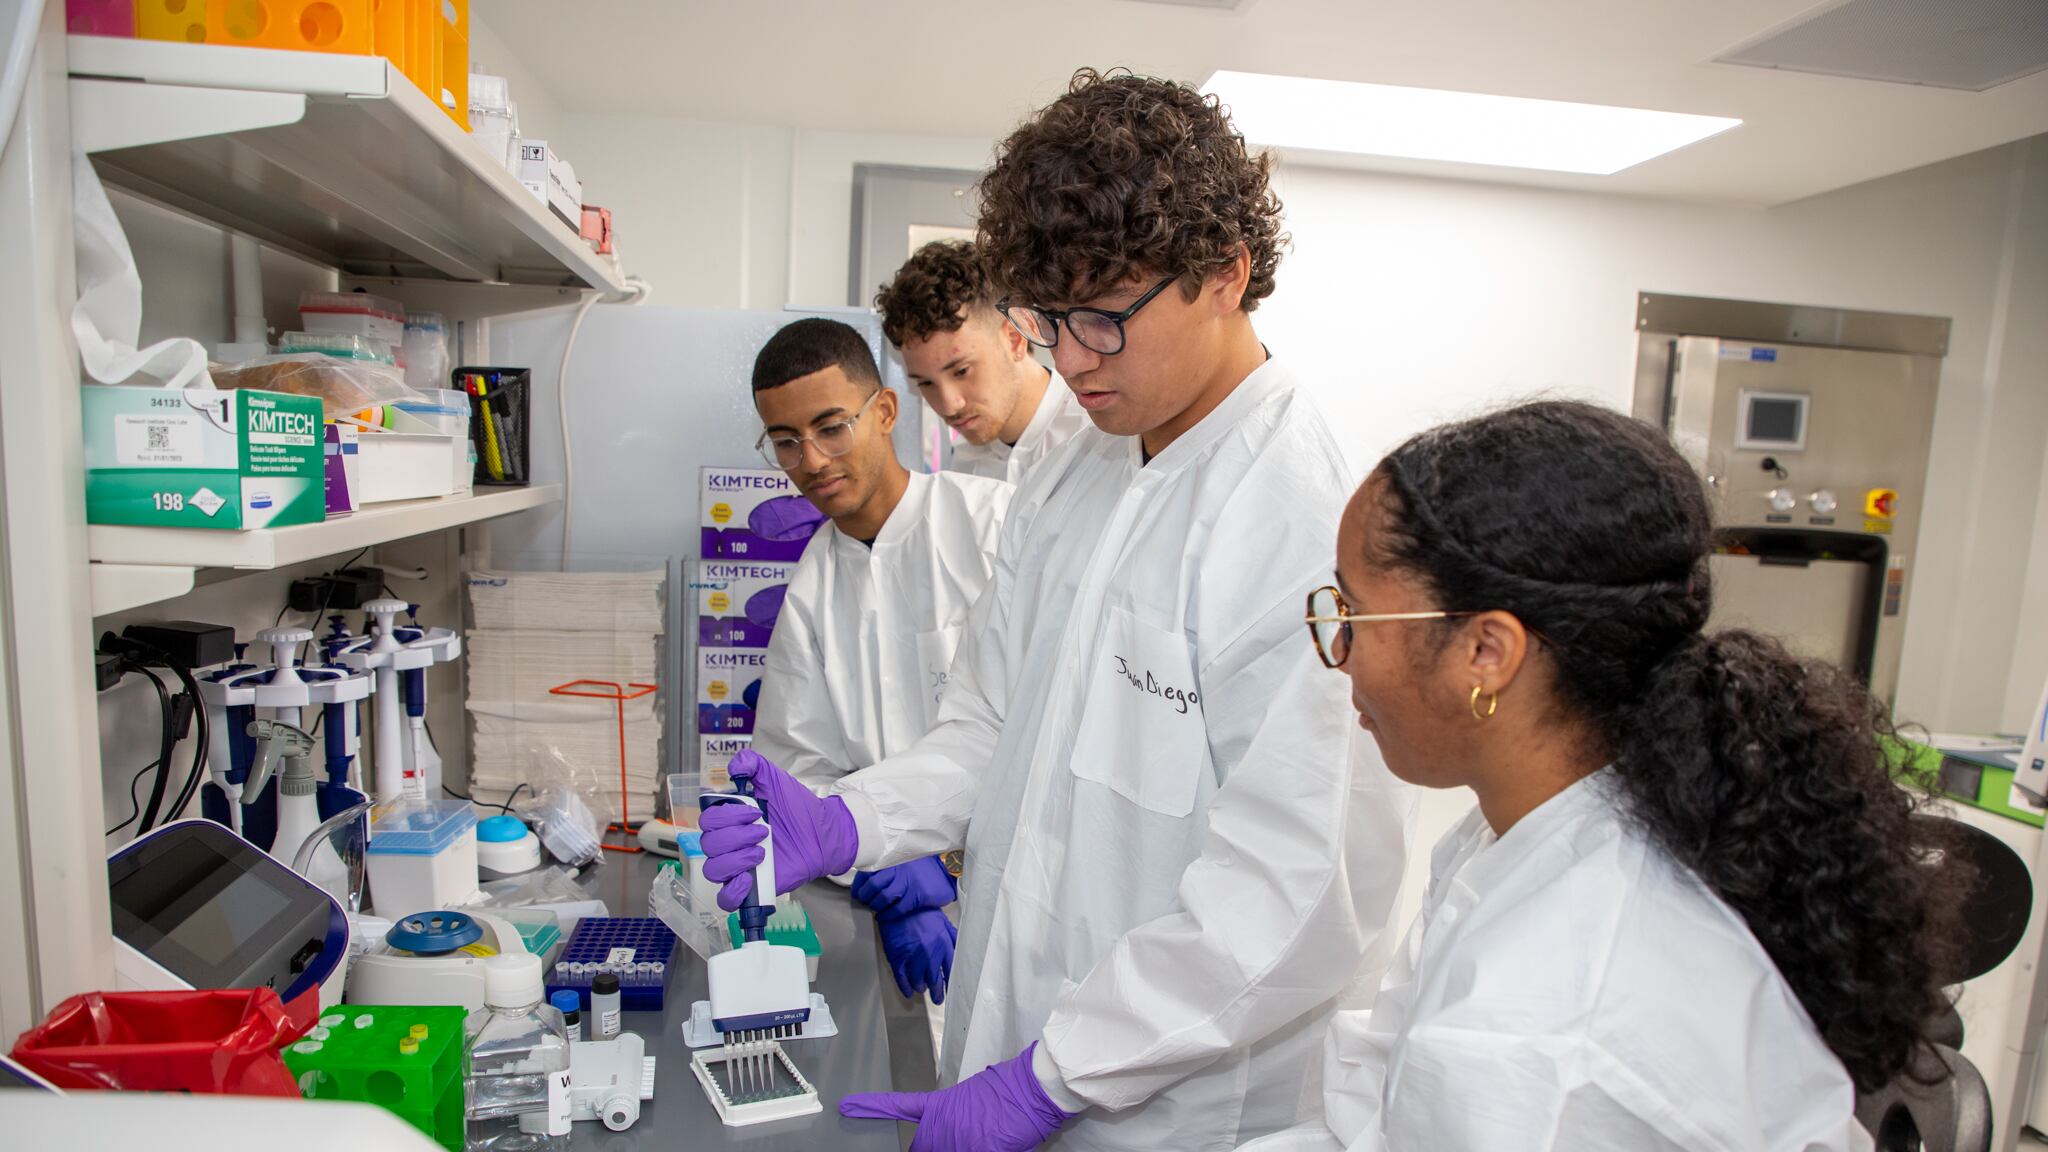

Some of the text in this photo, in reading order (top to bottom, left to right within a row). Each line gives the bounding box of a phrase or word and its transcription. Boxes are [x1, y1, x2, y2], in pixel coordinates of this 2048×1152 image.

[151, 398, 181, 408] 34133
[248, 409, 315, 434] KIMTECH
[709, 475, 788, 489] KIMTECH
[153, 493, 184, 511] 198
[731, 542, 748, 553] 100
[707, 565, 785, 579] KIMTECH
[729, 630, 745, 641] 100
[706, 653, 766, 666] KIMTEC
[727, 717, 744, 728] 200
